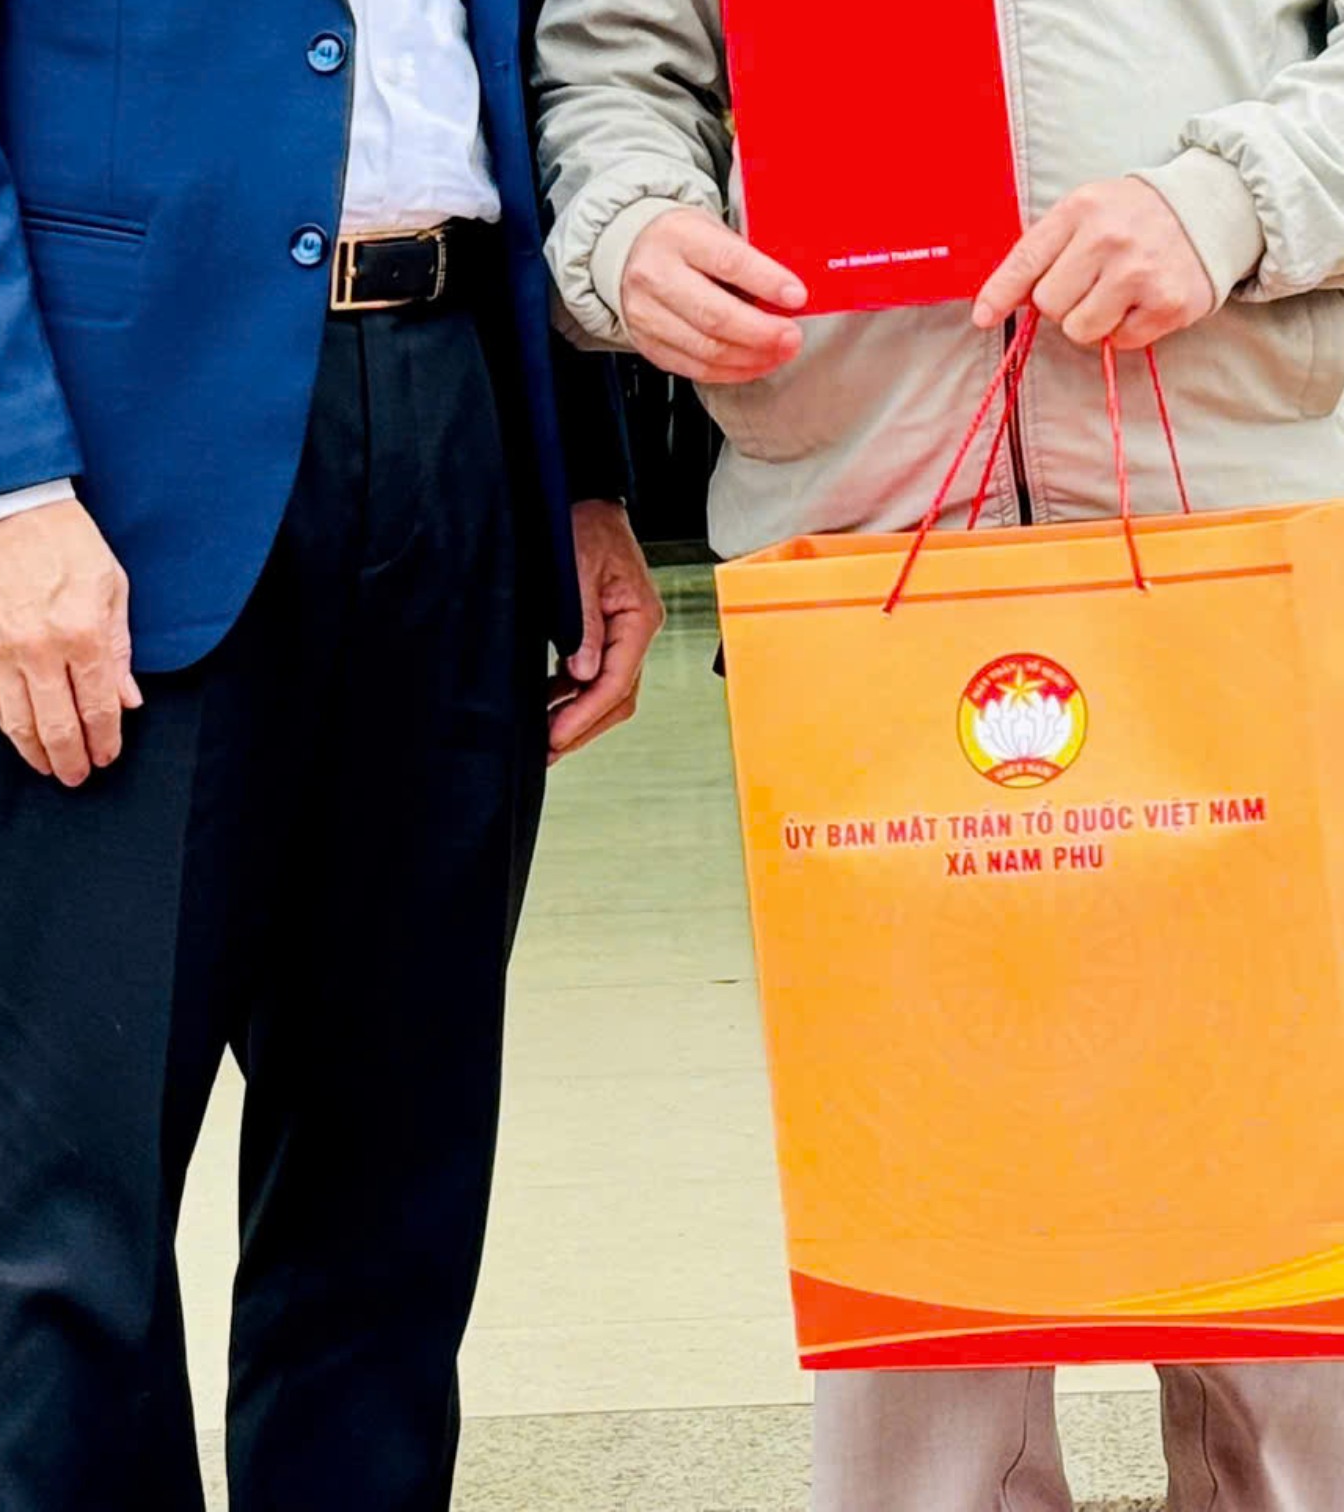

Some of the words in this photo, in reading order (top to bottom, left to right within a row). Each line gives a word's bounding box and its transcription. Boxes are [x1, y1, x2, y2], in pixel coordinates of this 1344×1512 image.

[785, 816, 816, 849] ỦY
[827, 822, 875, 847] BAN
[1021, 799, 1052, 835] TỔ
[1063, 798, 1133, 834] QUỐC
[1143, 794, 1199, 832] VIỆT
[1209, 797, 1266, 824] NAM
[987, 848, 1042, 873] NAM
